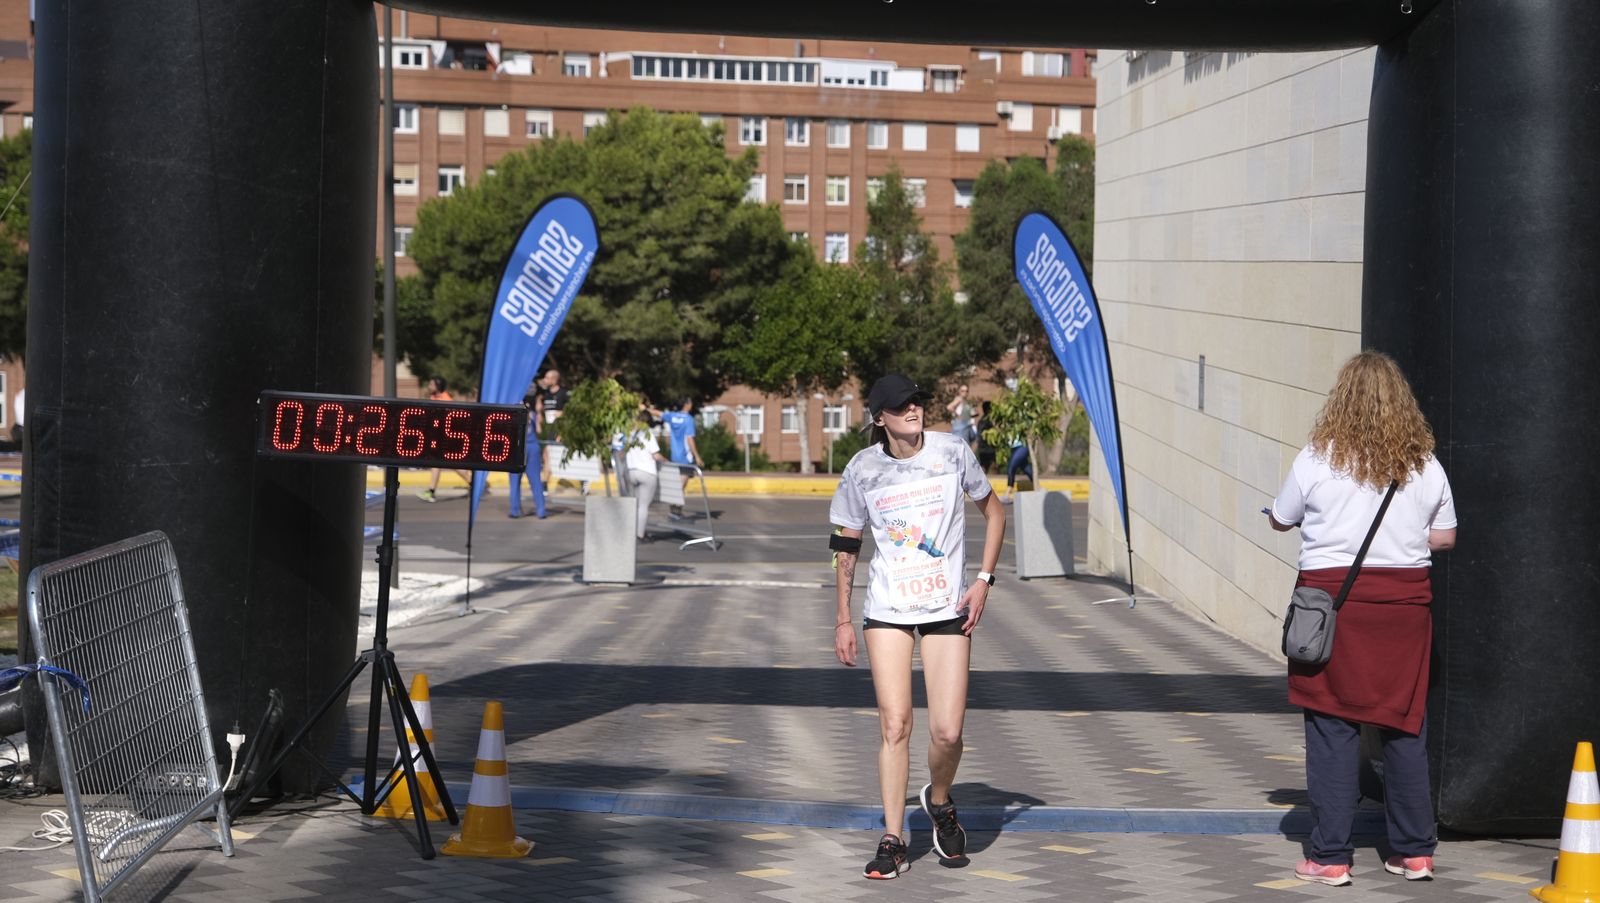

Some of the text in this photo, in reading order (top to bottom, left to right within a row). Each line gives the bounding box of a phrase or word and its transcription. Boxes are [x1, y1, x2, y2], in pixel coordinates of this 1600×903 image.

[538, 251, 595, 346] centrohogarsanchez.es
[273, 401, 511, 462] 00:26:56
[896, 573, 947, 597] 1036
